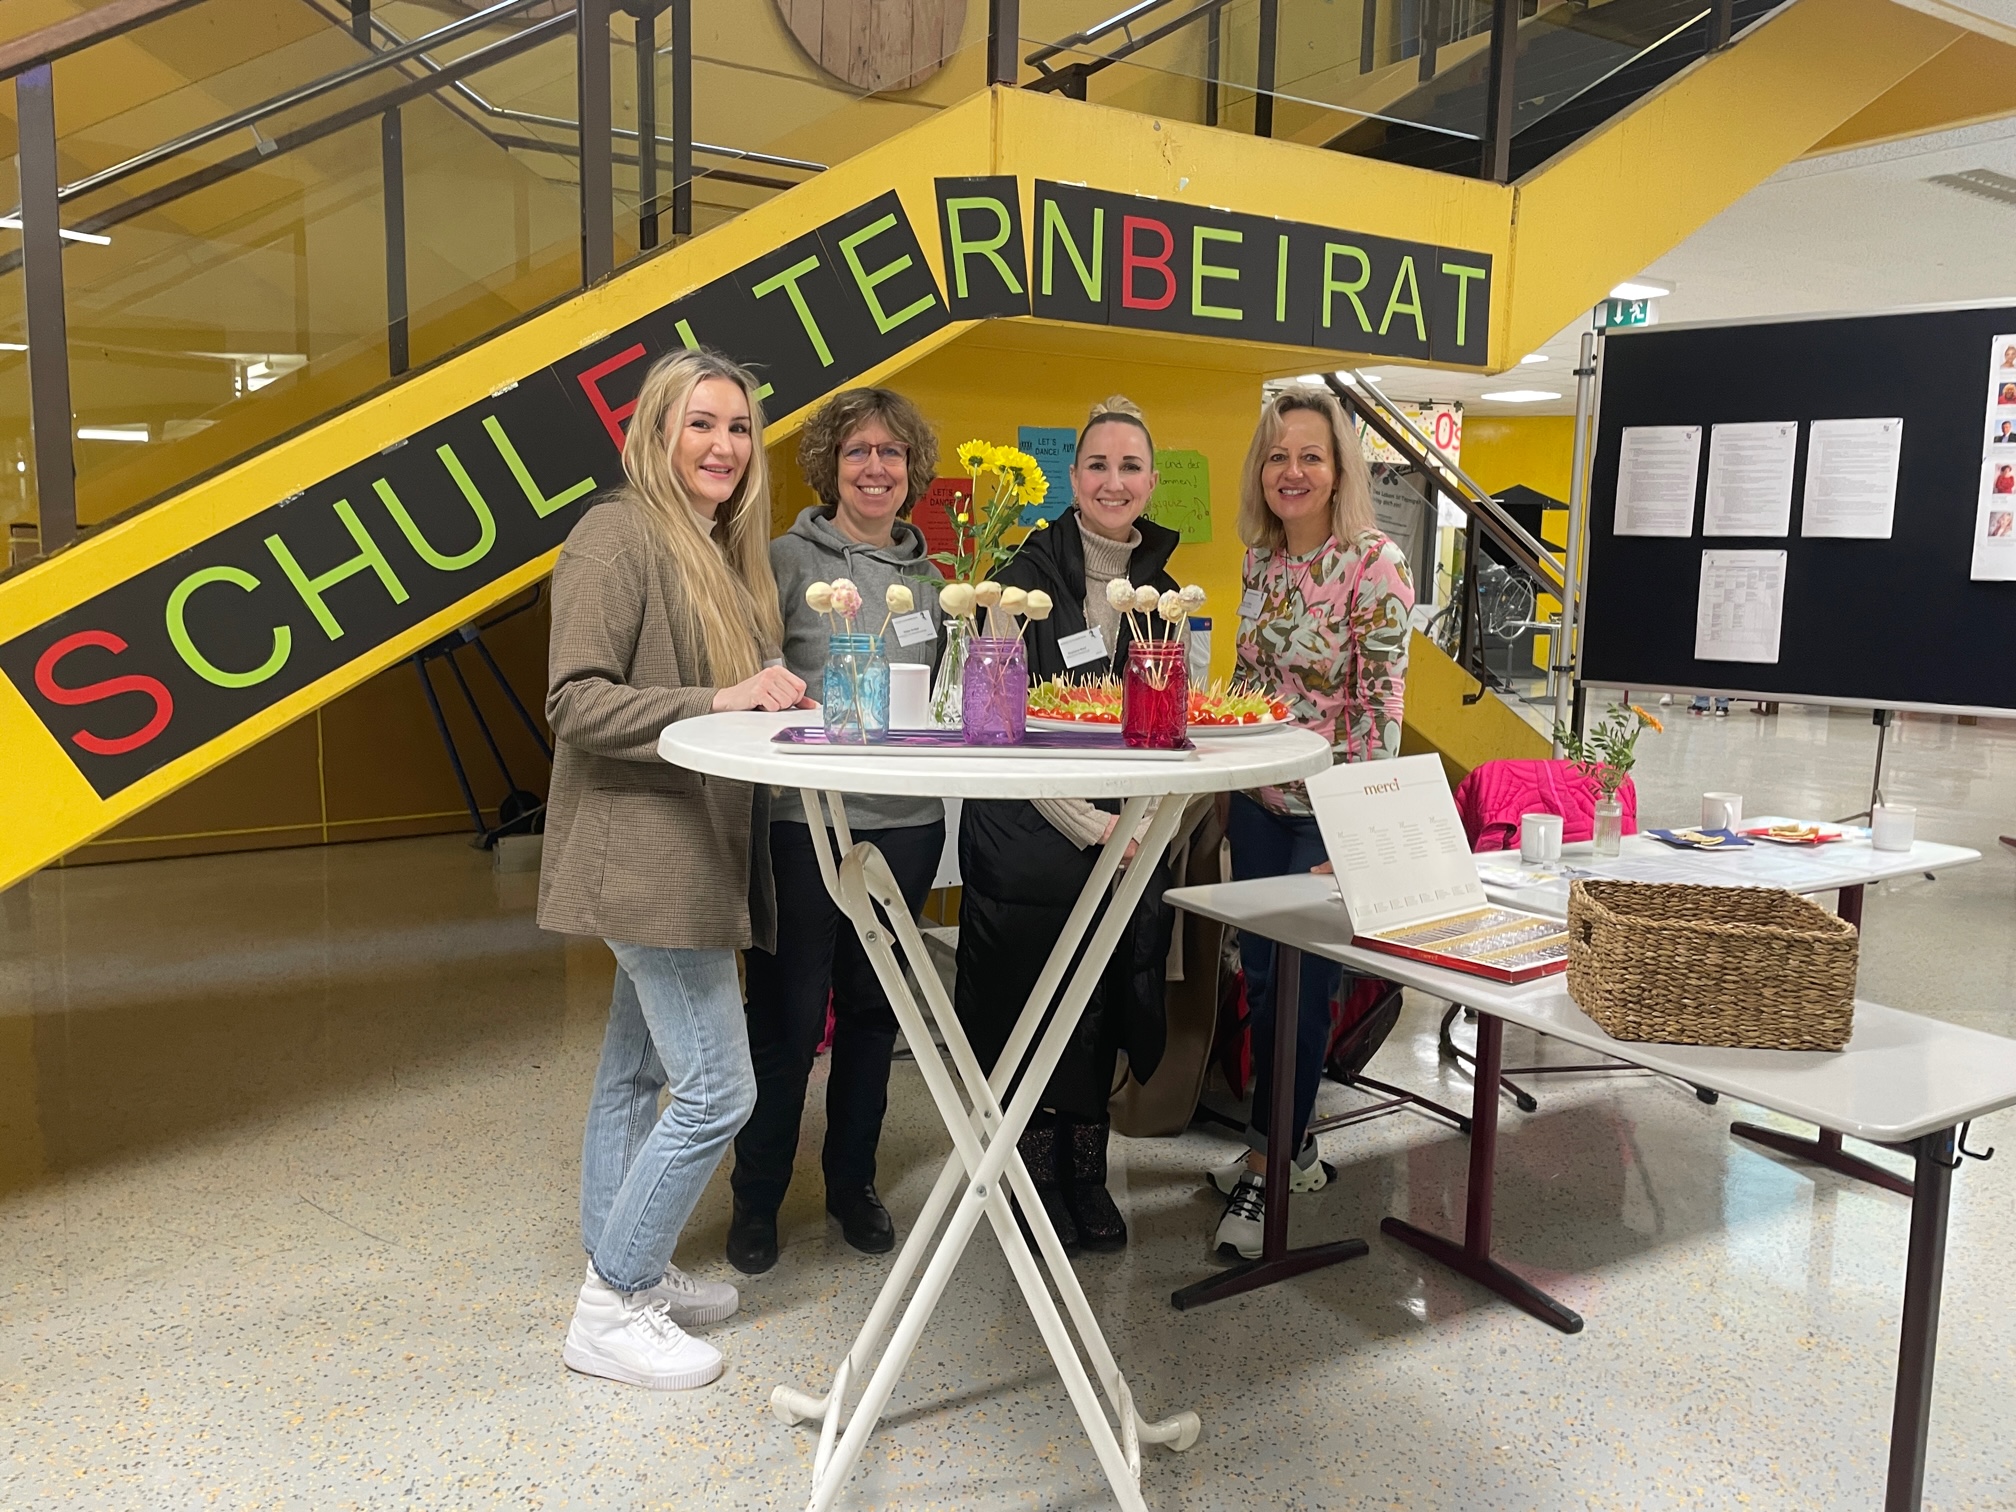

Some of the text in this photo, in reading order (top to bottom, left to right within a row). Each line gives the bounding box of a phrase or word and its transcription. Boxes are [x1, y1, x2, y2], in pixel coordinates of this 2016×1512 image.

[1035, 447, 1060, 456] DANCE!
[930, 498, 956, 507] DANCE
[1363, 777, 1401, 796] merci
